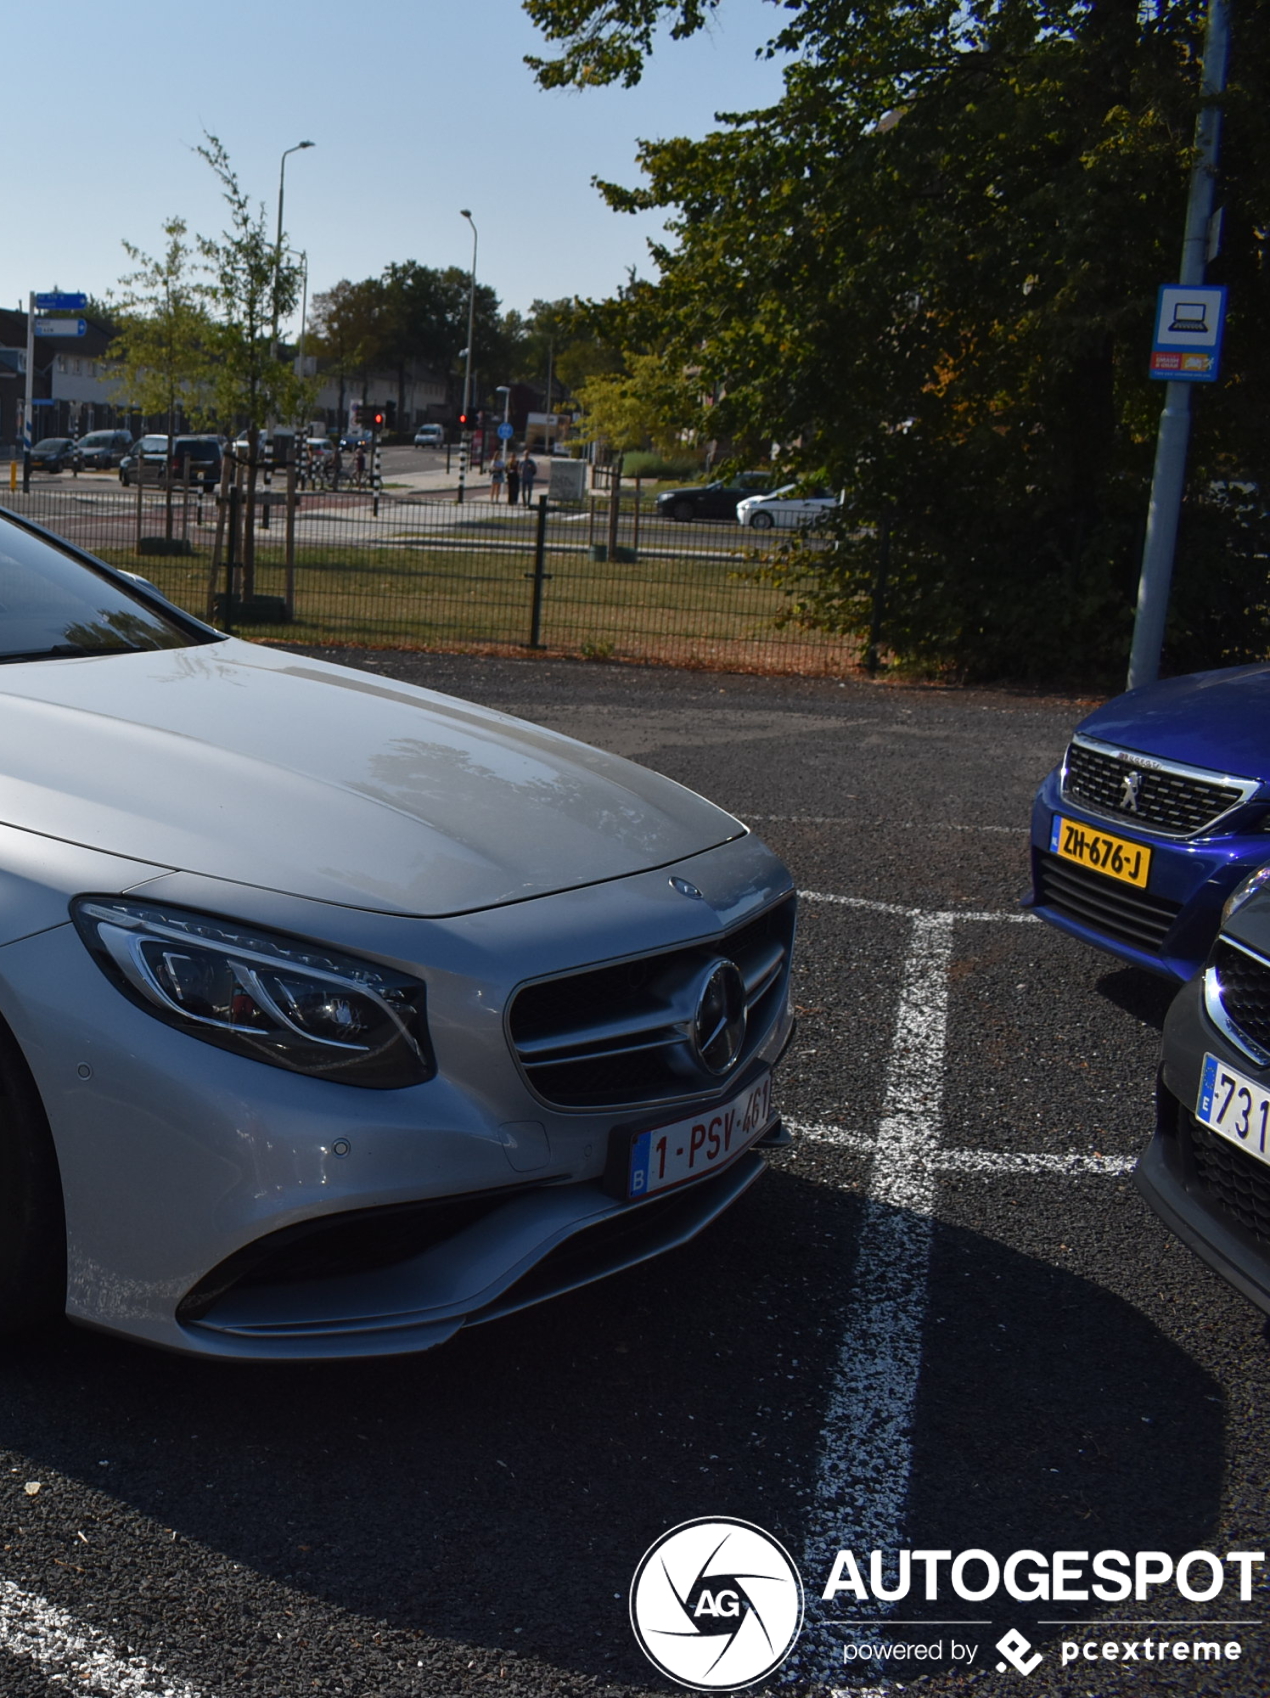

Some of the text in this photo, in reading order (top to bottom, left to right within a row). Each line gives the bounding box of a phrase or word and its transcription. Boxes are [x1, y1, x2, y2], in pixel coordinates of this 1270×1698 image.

[1063, 825, 1142, 880] ZH-676-J
[1202, 1095, 1210, 1112] E
[655, 1079, 770, 1180] 1-PSV-461
[633, 1169, 644, 1191] B
